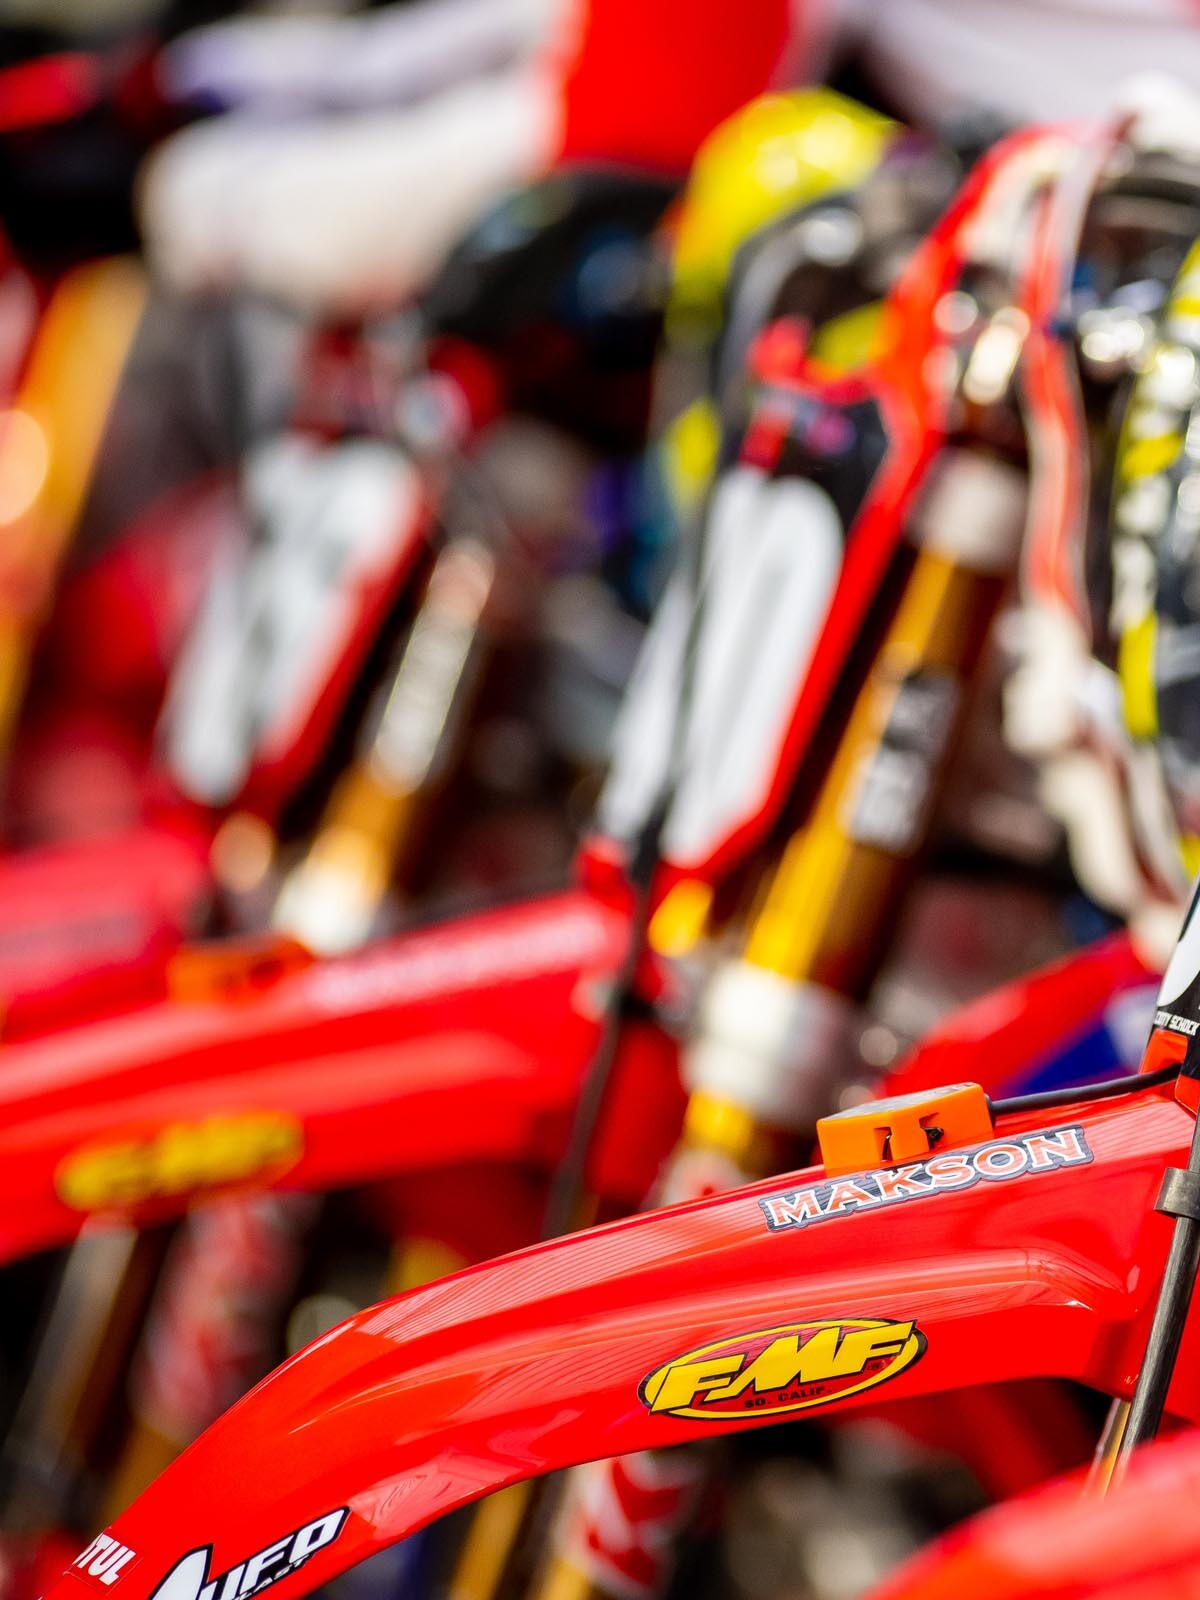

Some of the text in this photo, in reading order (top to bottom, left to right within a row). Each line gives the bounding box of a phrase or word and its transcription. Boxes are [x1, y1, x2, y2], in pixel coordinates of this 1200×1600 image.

[763, 1127, 1087, 1227] MAKSON
[649, 1320, 916, 1413] FMF
[777, 1386, 833, 1403] CALIF.
